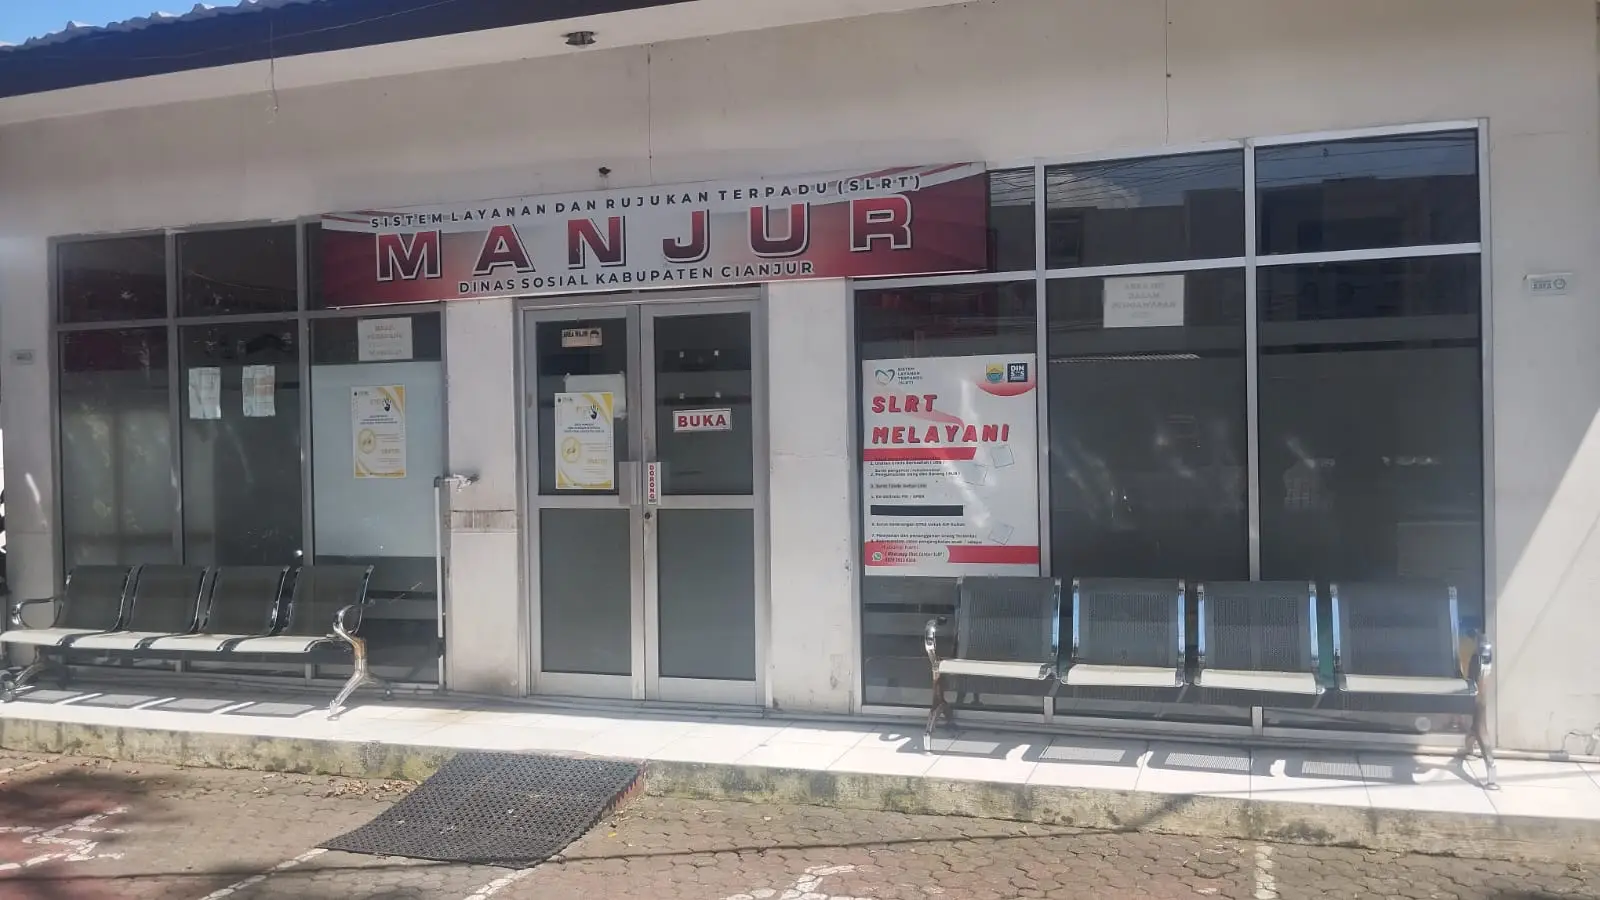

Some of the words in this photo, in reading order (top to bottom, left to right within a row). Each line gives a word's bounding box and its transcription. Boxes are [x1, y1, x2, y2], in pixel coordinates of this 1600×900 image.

[371, 213, 443, 228] SISTEM
[451, 203, 547, 222] LAYANAN
[555, 200, 597, 213] DAN
[605, 191, 708, 209] RUJUKAN
[718, 181, 828, 201] TERPADU
[837, 174, 921, 195] (SLRT)
[375, 194, 913, 282] MANJUR
[459, 278, 516, 293] DINAS
[521, 271, 589, 290] SOSIAL
[595, 267, 714, 285] KABUPATEN
[721, 261, 814, 278] CIANJUR
[872, 394, 938, 414] SLRT
[677, 414, 727, 428] BUKA
[872, 423, 1010, 444] MELAYANI
